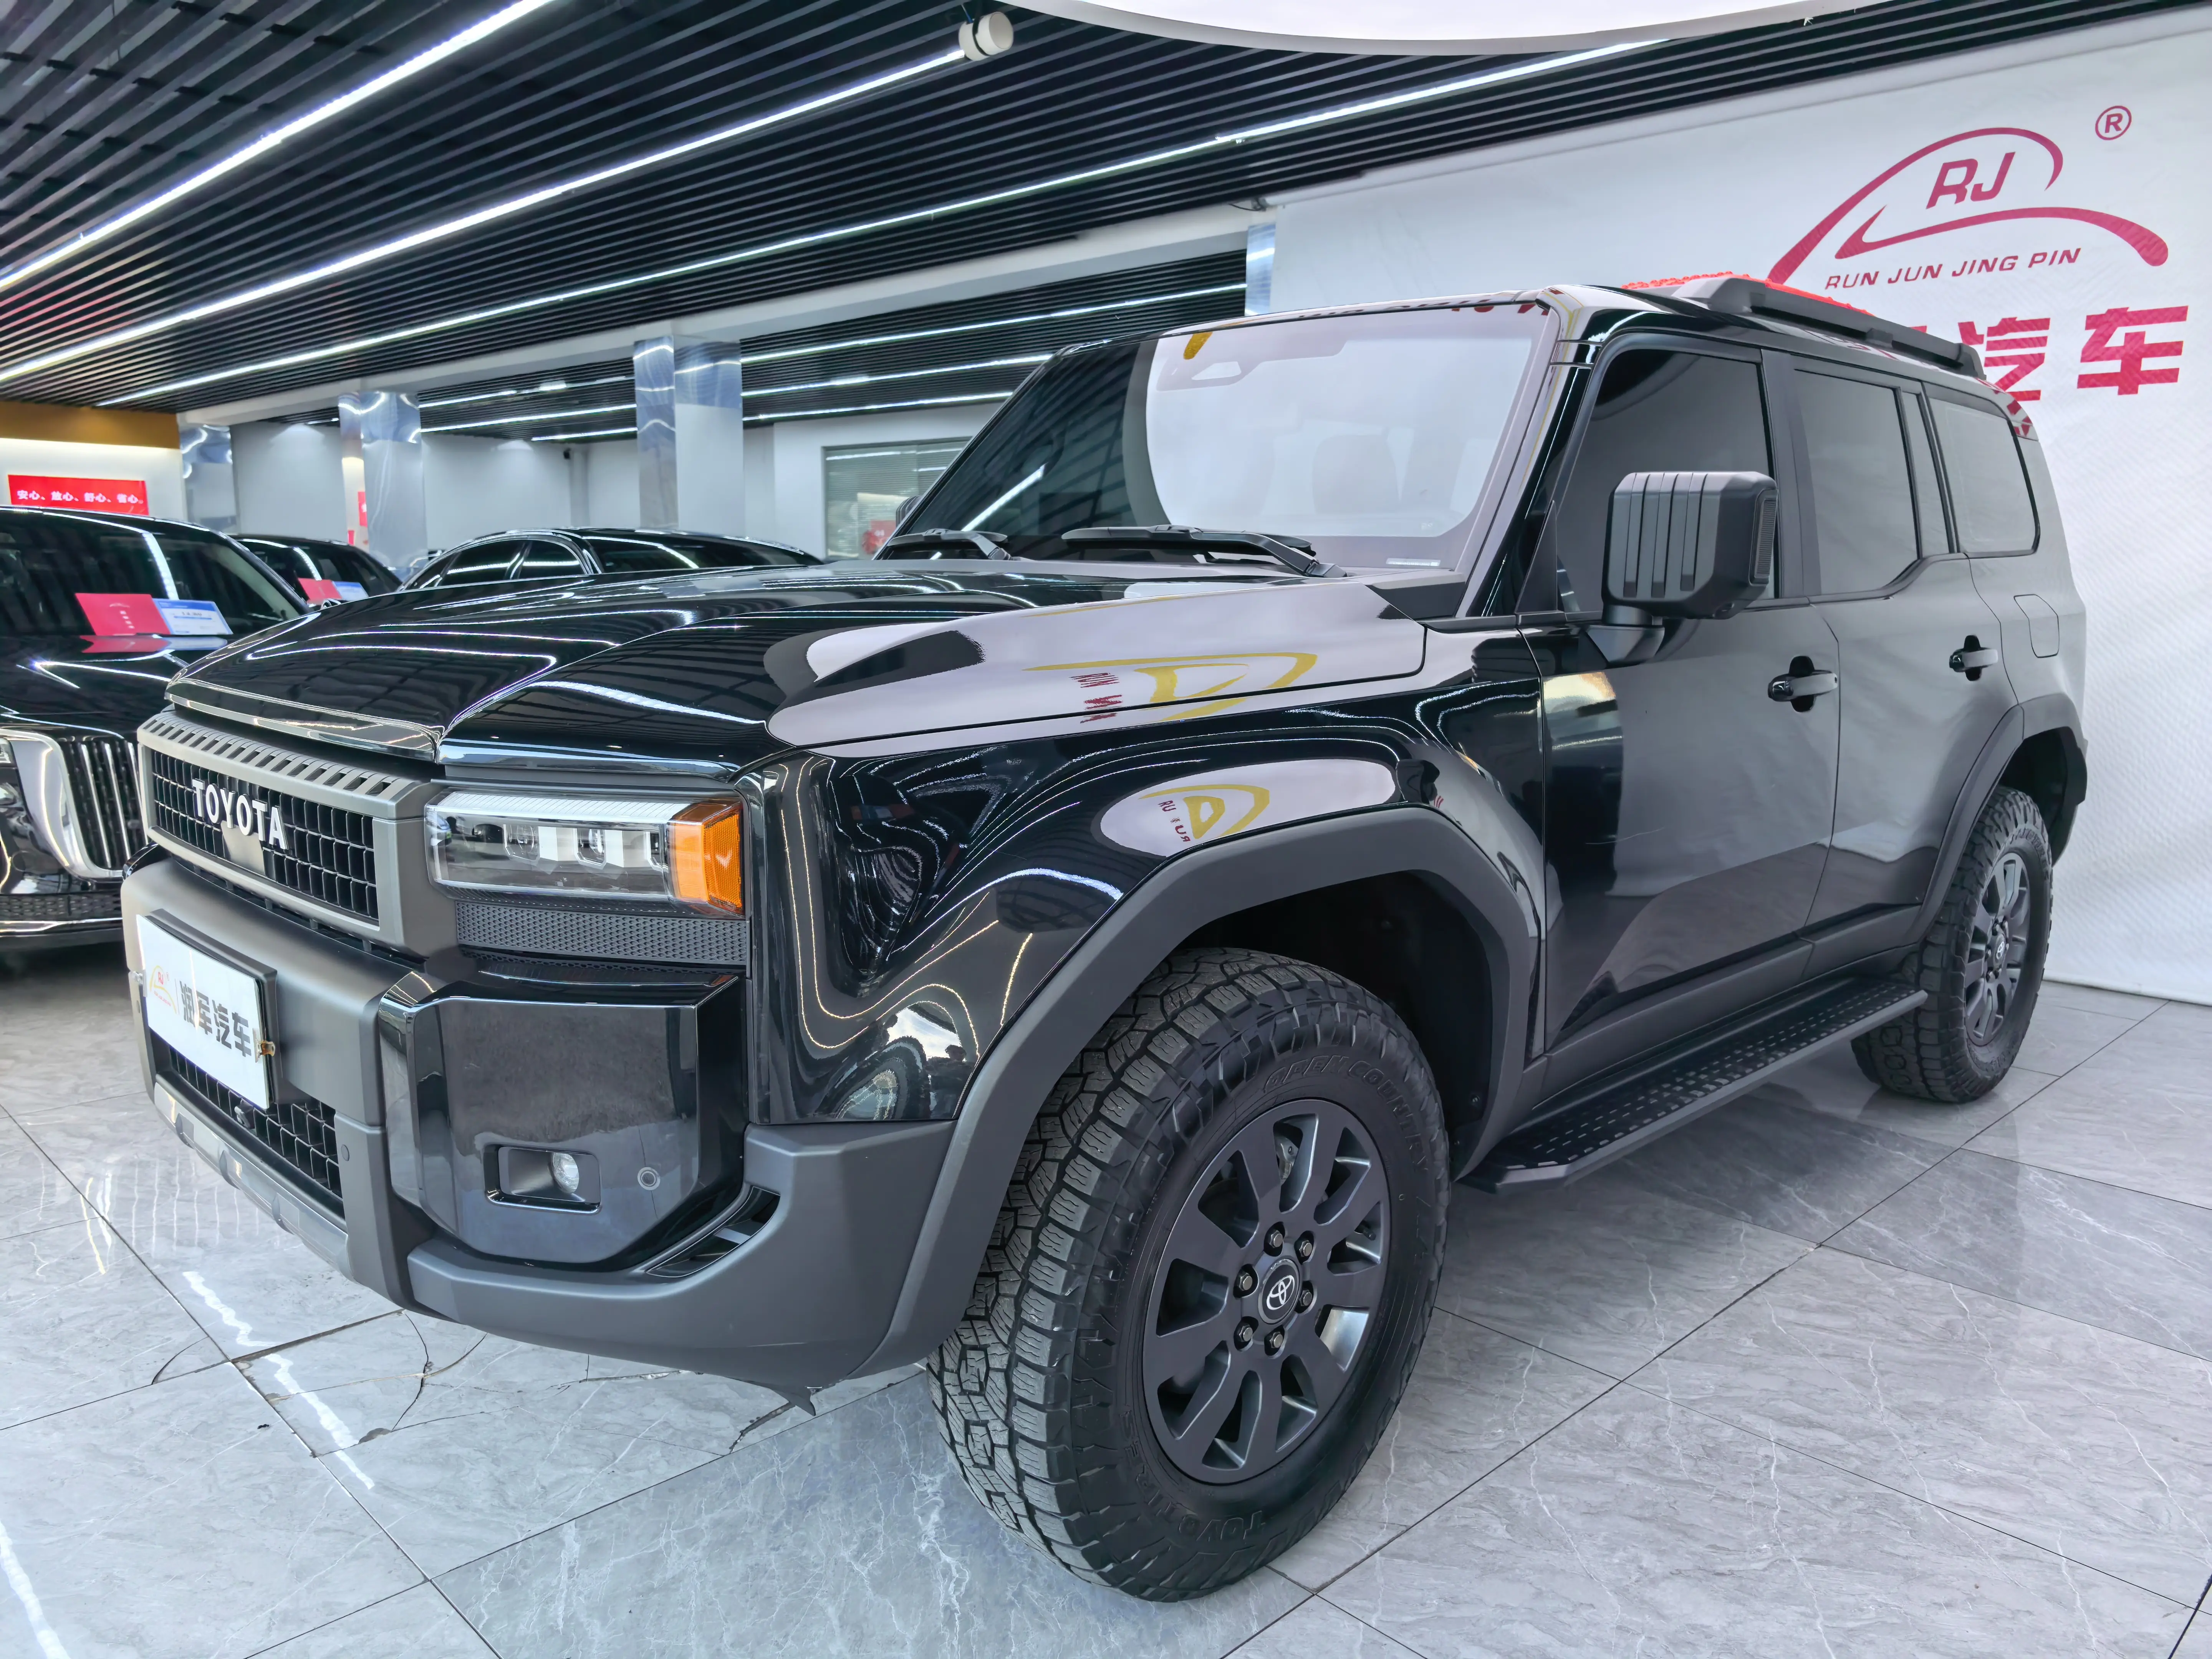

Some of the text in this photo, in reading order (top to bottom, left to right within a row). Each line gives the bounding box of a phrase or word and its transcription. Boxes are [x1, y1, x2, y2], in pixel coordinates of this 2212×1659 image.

[1926, 151, 2016, 210] RJ
[1824, 248, 2081, 290] RUN JUN JING PIN
[1909, 305, 2189, 401] 汽车
[192, 778, 289, 849] TOYOTA
[1263, 1055, 1349, 1093] OPEN
[1178, 1510, 1267, 1544] TOYO
